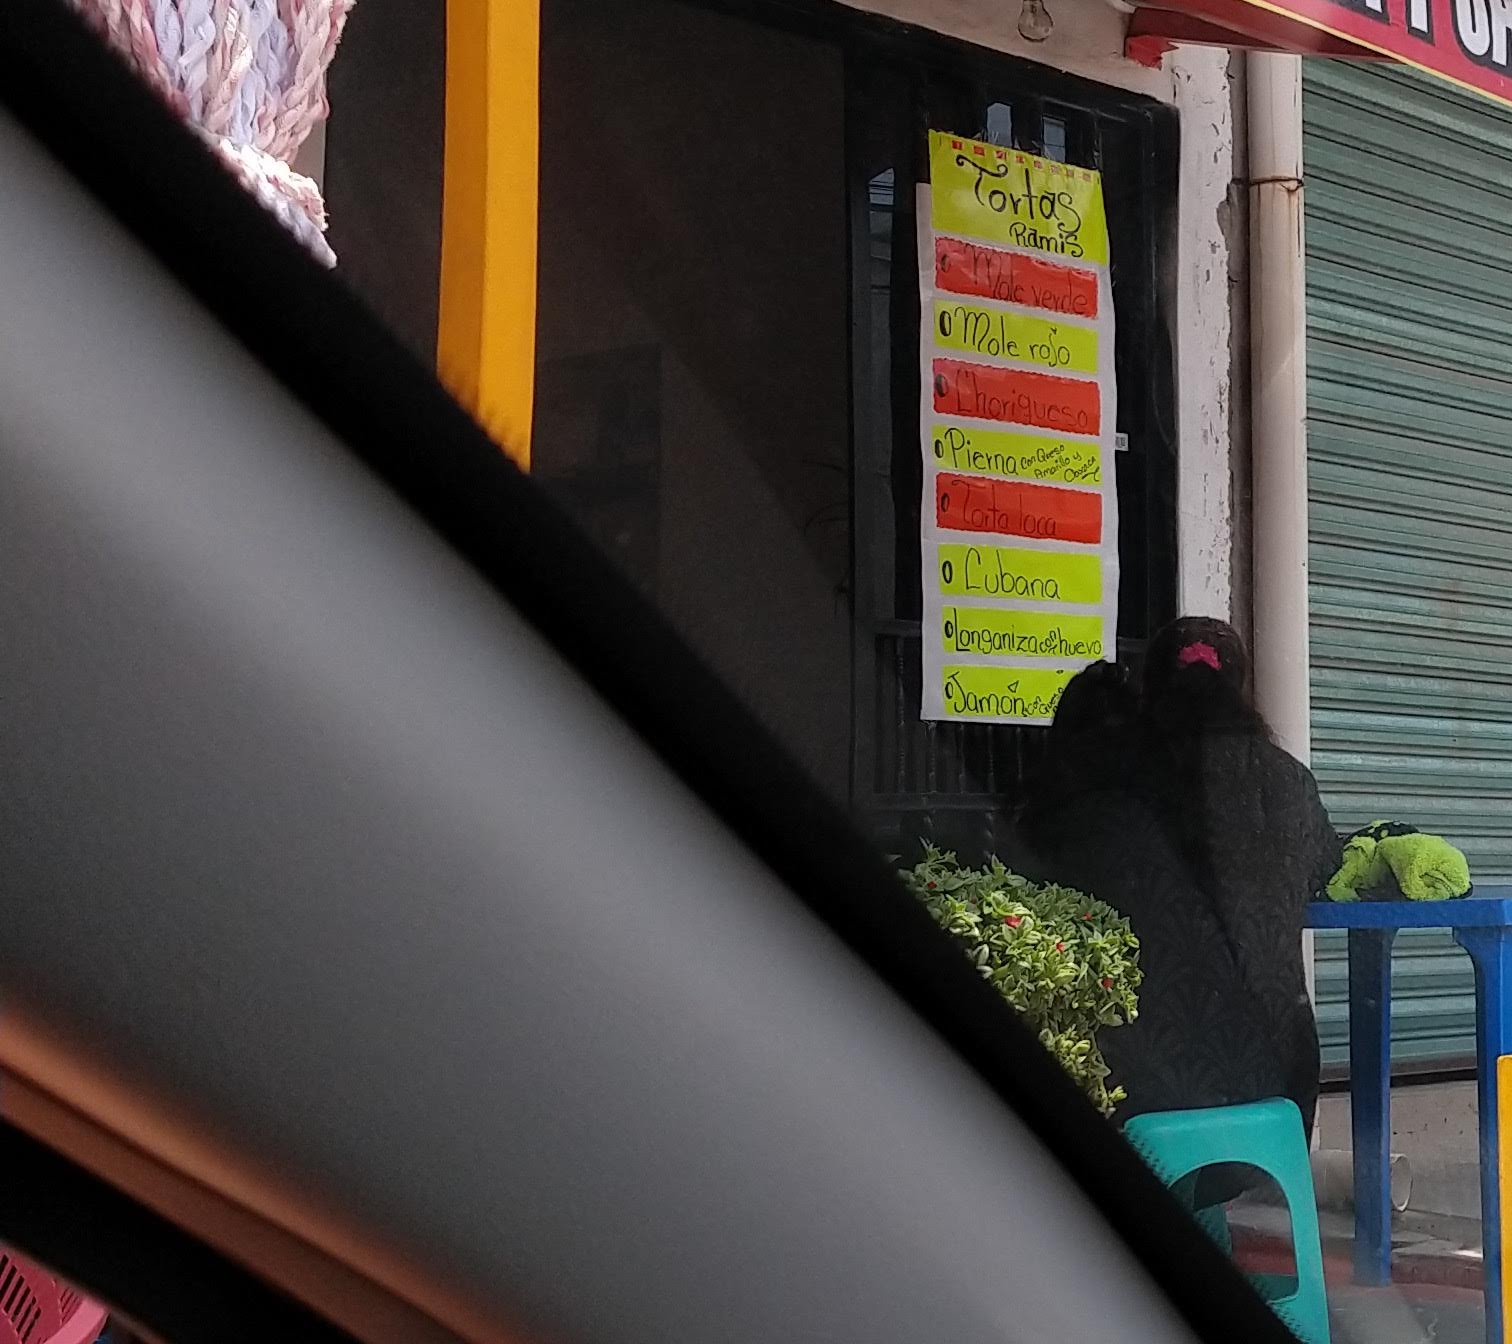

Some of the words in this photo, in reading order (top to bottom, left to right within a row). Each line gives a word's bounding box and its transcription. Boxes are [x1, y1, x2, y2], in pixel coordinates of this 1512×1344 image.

[956, 155, 1081, 233] Tortas
[964, 244, 1024, 300] Mole
[954, 306, 1020, 357] Mole
[1029, 327, 1070, 367] rojo
[944, 428, 1018, 475] Pierna
[952, 480, 1009, 529] Torta
[1019, 494, 1057, 535] loca
[965, 547, 1060, 599] Cubana
[953, 608, 1038, 654] Longaniza
[1057, 627, 1102, 656] huevo
